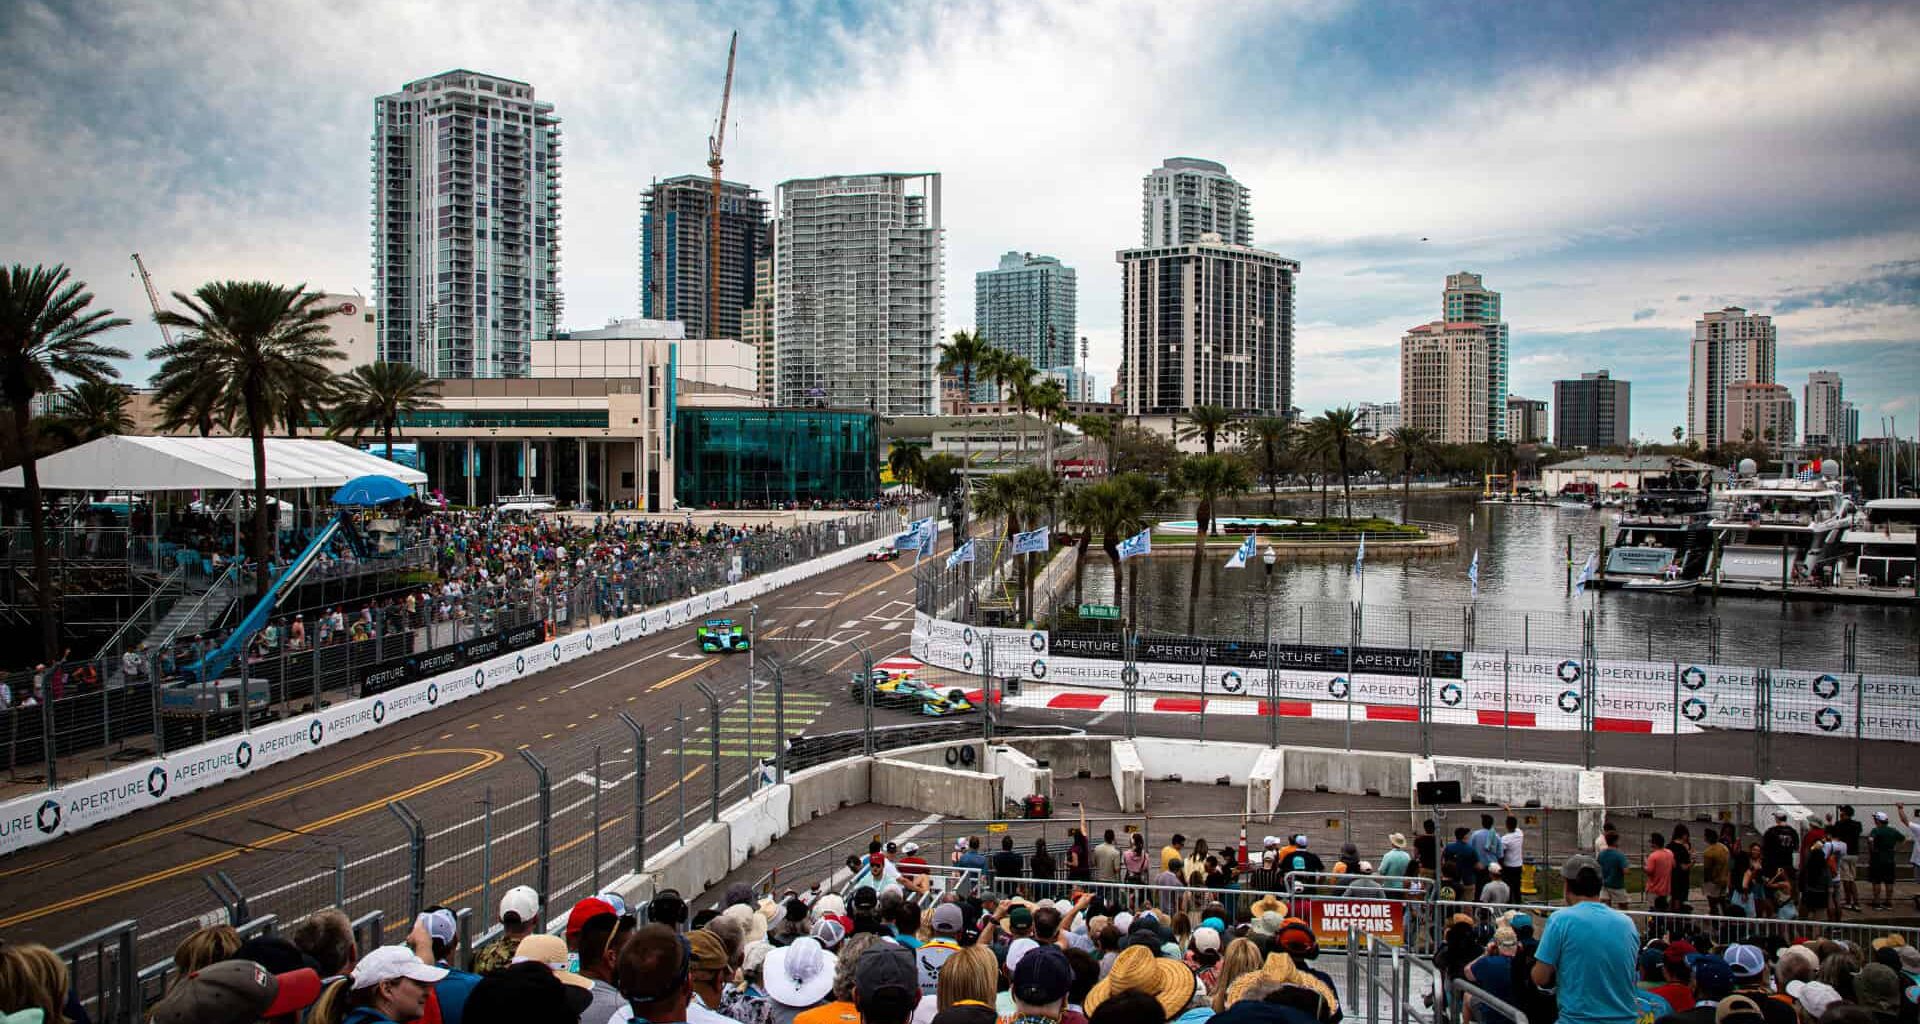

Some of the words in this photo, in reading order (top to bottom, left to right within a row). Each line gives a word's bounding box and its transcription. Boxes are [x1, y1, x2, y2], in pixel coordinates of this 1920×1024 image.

[1055, 639, 1119, 652] APERTURE
[1147, 645, 1217, 657] APERTURE
[419, 652, 455, 671] APERTURE
[1472, 660, 1553, 675] APERTURE
[366, 666, 405, 685] APERTURE
[1055, 667, 1117, 679] APERTURE
[389, 692, 427, 710] APERTURE
[1473, 691, 1553, 706] APERTURE
[328, 709, 372, 732] APERTURE
[258, 729, 308, 754] APERTURE
[174, 753, 234, 781] APERTURE
[70, 780, 145, 814] APERTURE
[1323, 903, 1391, 918] WELCOME
[1322, 918, 1393, 932] RACEFANS
